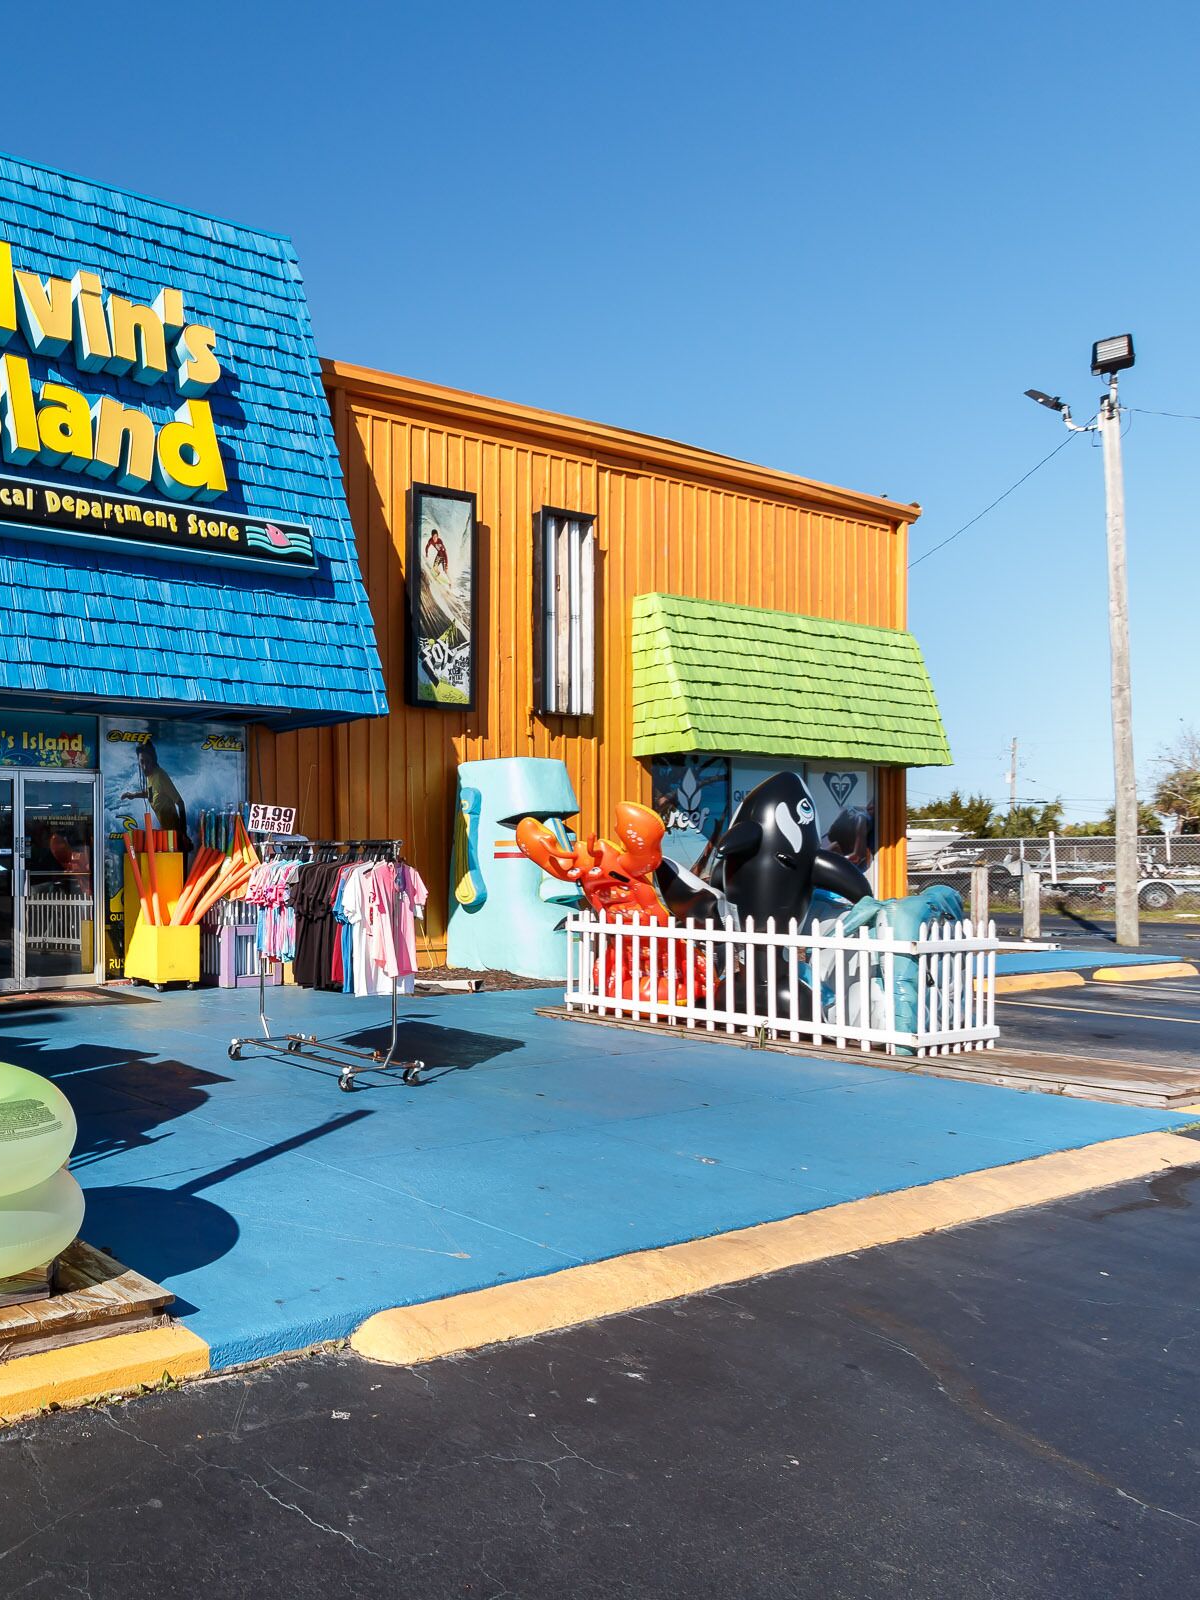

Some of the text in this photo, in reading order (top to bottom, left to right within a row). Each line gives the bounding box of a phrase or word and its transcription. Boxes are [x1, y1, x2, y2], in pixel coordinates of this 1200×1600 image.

[45, 491, 178, 533] Department
[188, 514, 240, 542] Store
[22, 731, 83, 751] Island
[122, 732, 152, 745] REEF
[202, 735, 242, 750] Hobie
[252, 805, 294, 823] $1.99
[667, 807, 710, 834] reef
[250, 819, 292, 833] 10 FOR $10
